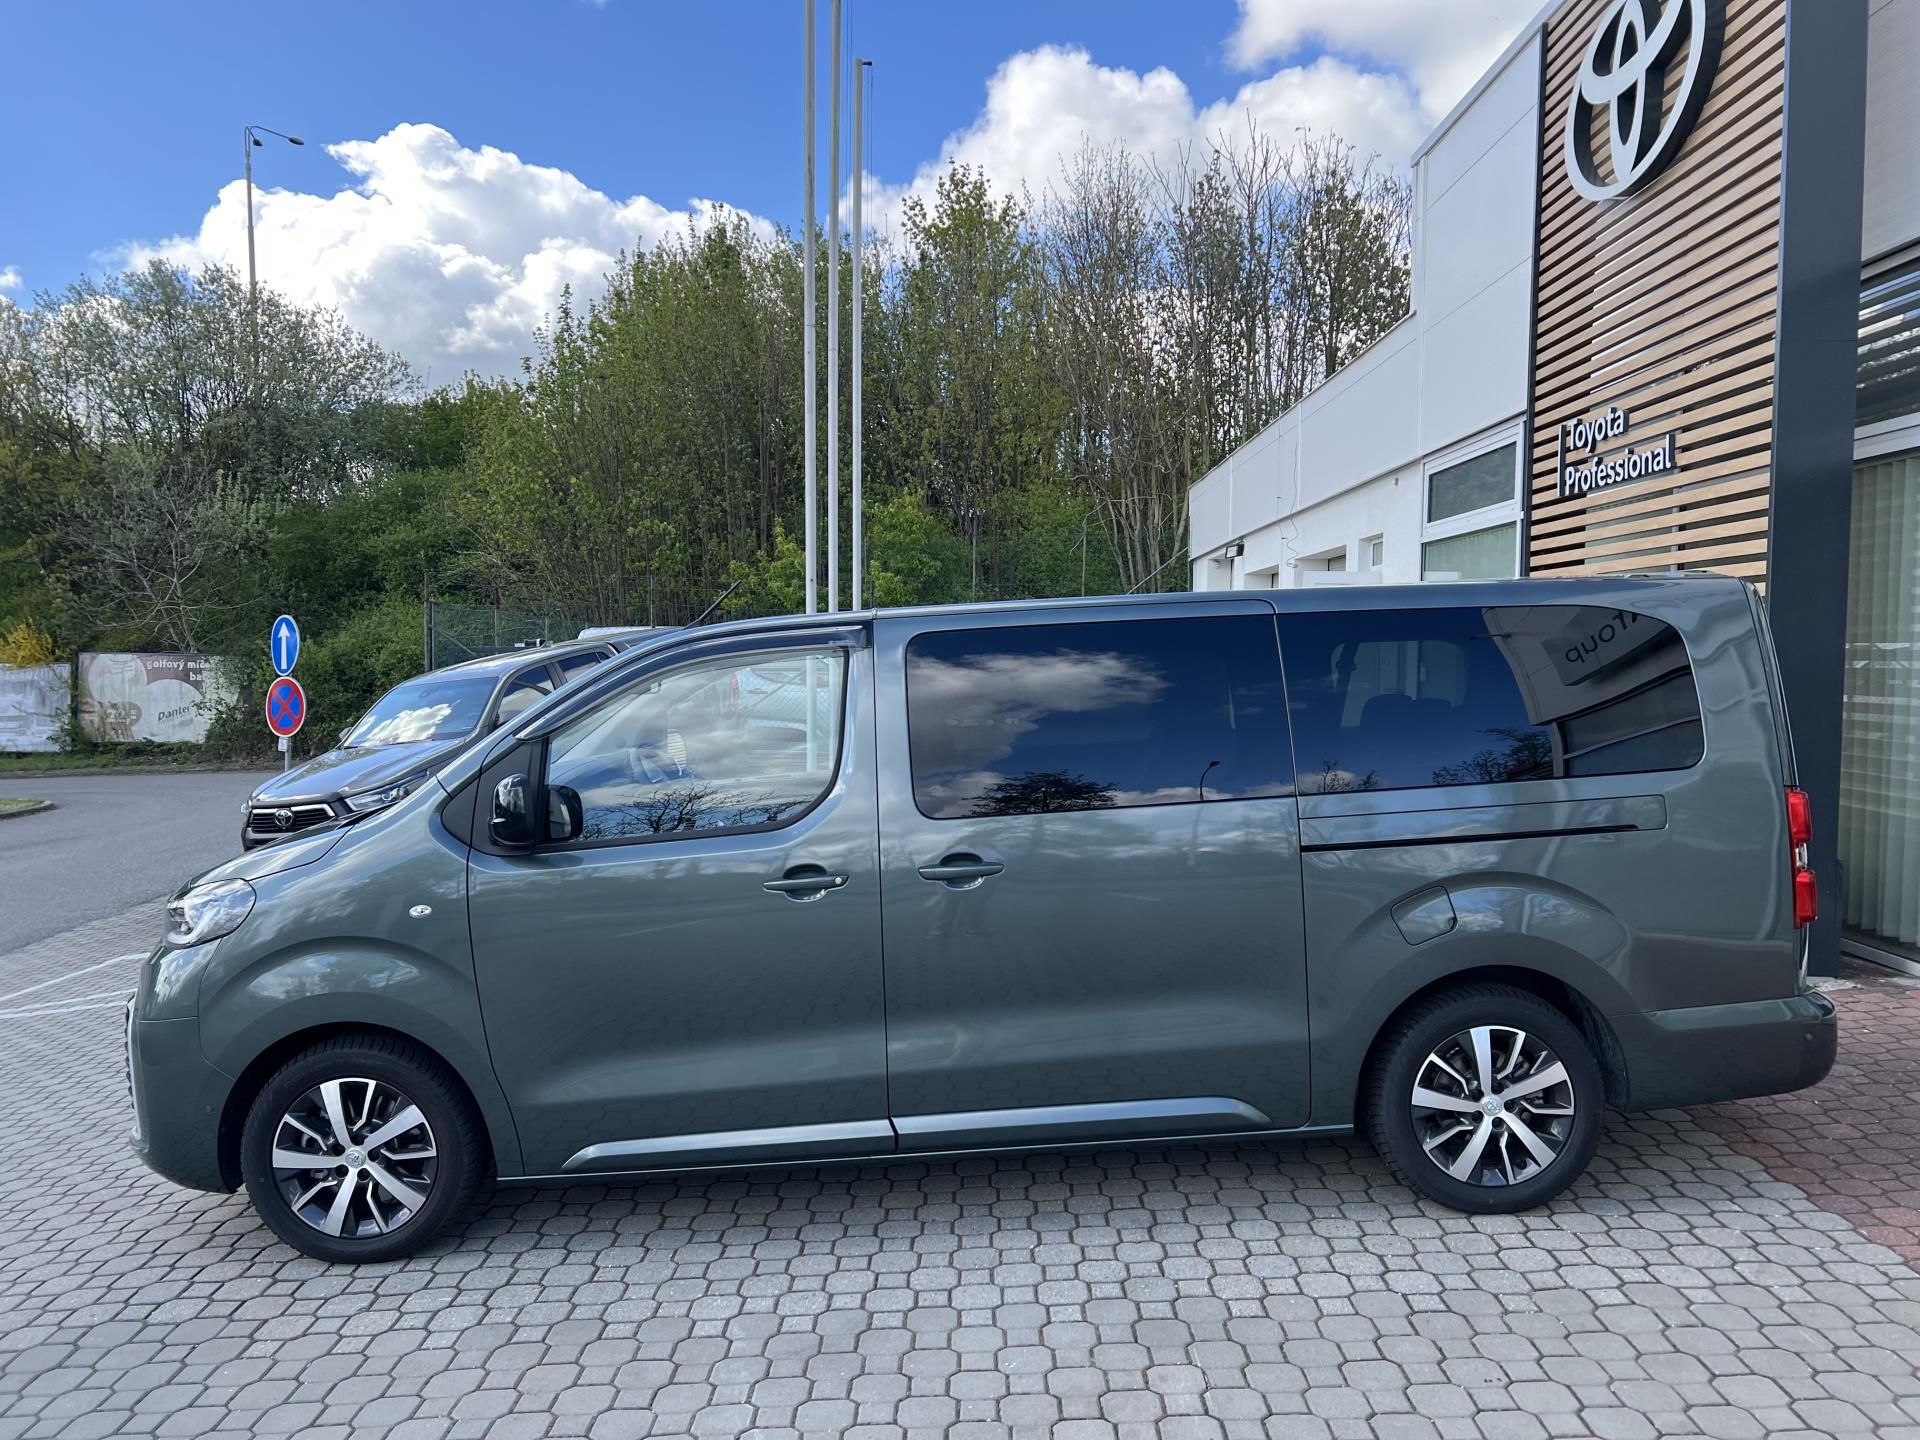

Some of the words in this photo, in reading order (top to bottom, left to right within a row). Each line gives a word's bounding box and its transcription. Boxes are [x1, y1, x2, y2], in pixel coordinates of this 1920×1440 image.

[1568, 407, 1626, 454] Toyota
[1565, 433, 1672, 496] Professional
[146, 659, 185, 671] golfový
